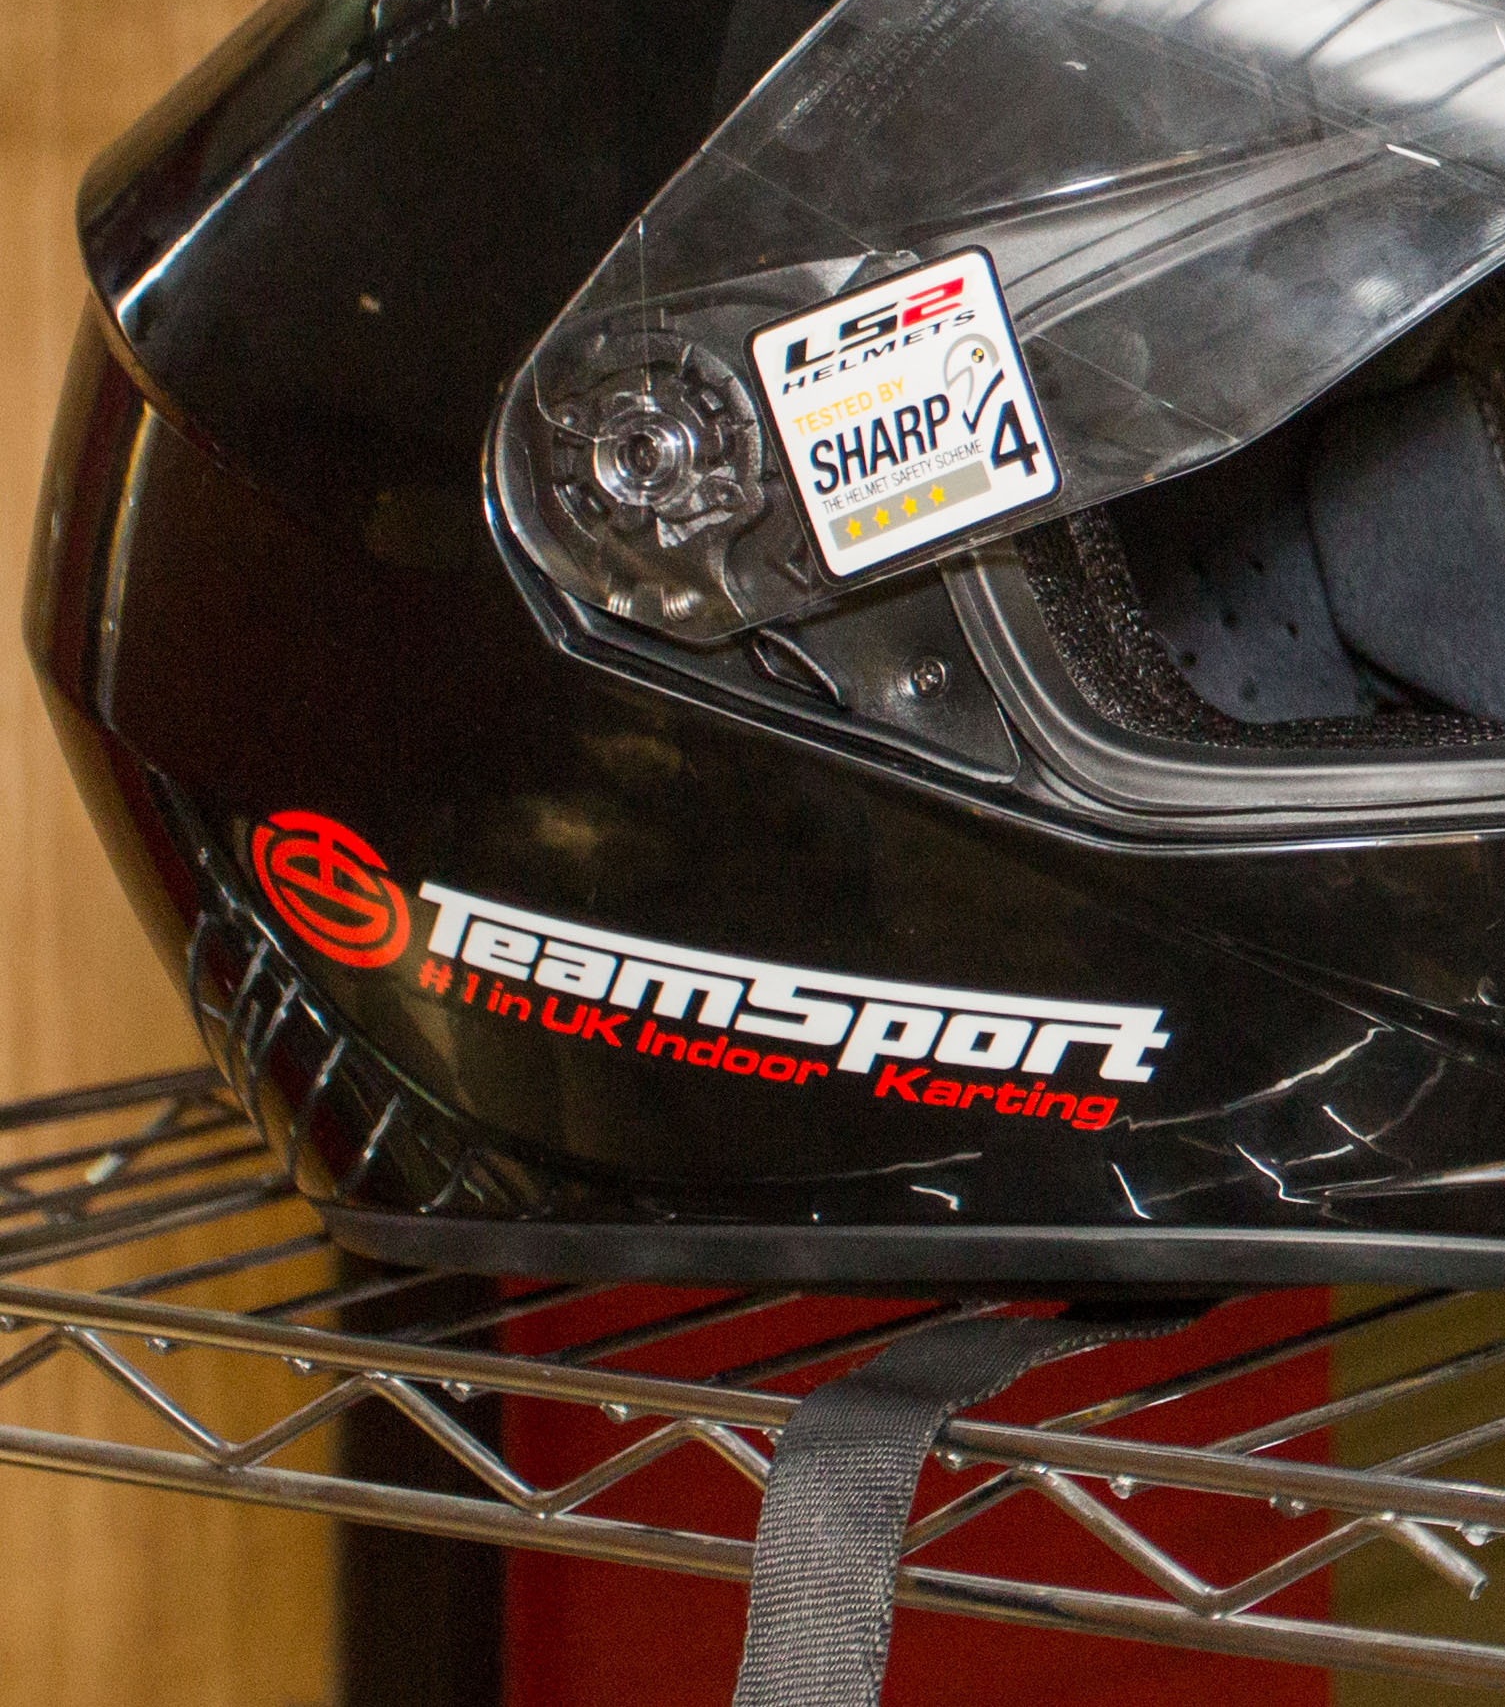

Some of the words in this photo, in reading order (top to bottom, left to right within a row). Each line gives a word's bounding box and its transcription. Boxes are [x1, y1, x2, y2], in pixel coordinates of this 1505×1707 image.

[782, 309, 976, 395] HELMETS
[784, 277, 965, 374] LS2
[792, 393, 873, 437] TESTED
[880, 376, 905, 404] BY
[809, 393, 951, 495] SHARP
[989, 399, 1040, 478] 4
[822, 497, 844, 514] THE
[846, 477, 889, 503] HELMET
[892, 460, 933, 486] SAFETY
[935, 439, 984, 469] SCHEME
[418, 882, 1172, 1083] TeamSport
[486, 981, 532, 1021] in
[541, 996, 630, 1047] UK
[635, 1020, 829, 1085] Indoor
[873, 1063, 1118, 1132] Karting
